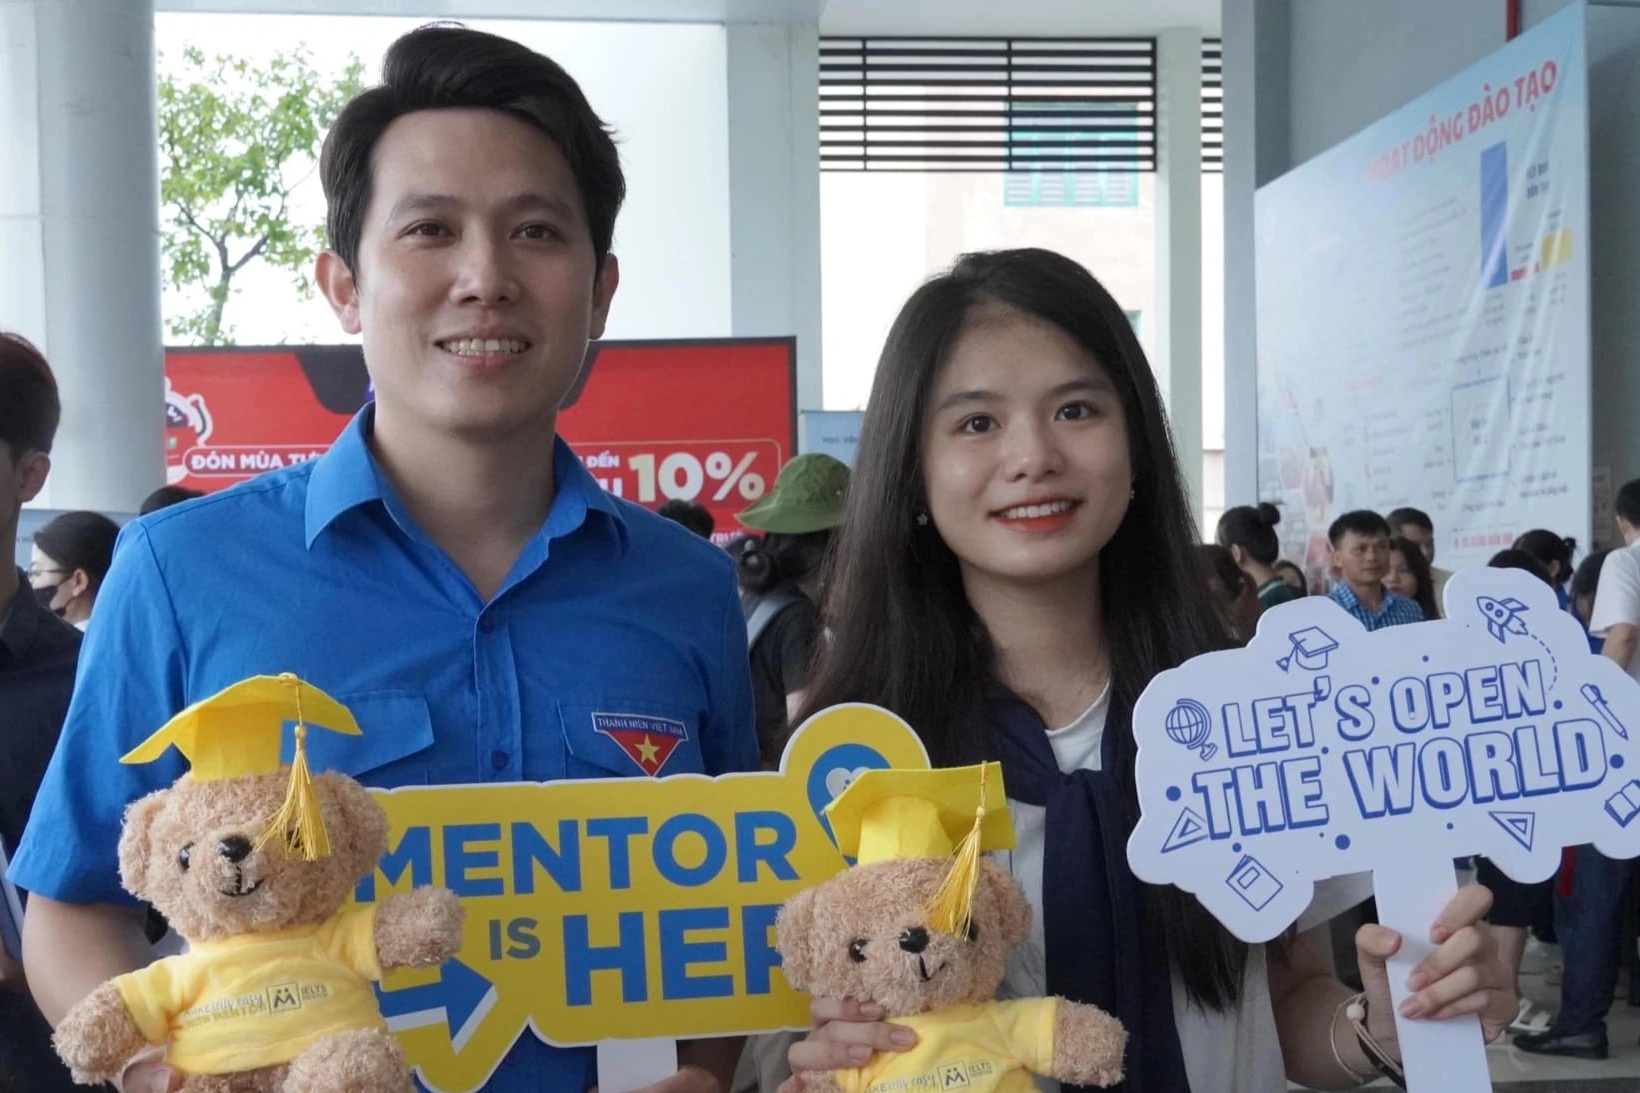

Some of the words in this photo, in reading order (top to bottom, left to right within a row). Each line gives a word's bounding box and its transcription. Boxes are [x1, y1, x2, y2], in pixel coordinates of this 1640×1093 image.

[1514, 60, 1558, 113] TẠO
[191, 450, 235, 470] ĐÓN
[240, 450, 283, 470] MÙA
[586, 451, 620, 468] ĐẾN
[628, 451, 766, 502] 10%
[1222, 675, 1376, 758] LET'S
[1389, 659, 1547, 734] OPEN
[1193, 756, 1330, 840] THE
[1342, 717, 1608, 820] WORLD
[354, 810, 800, 904] MENTOR
[490, 917, 542, 961] IS
